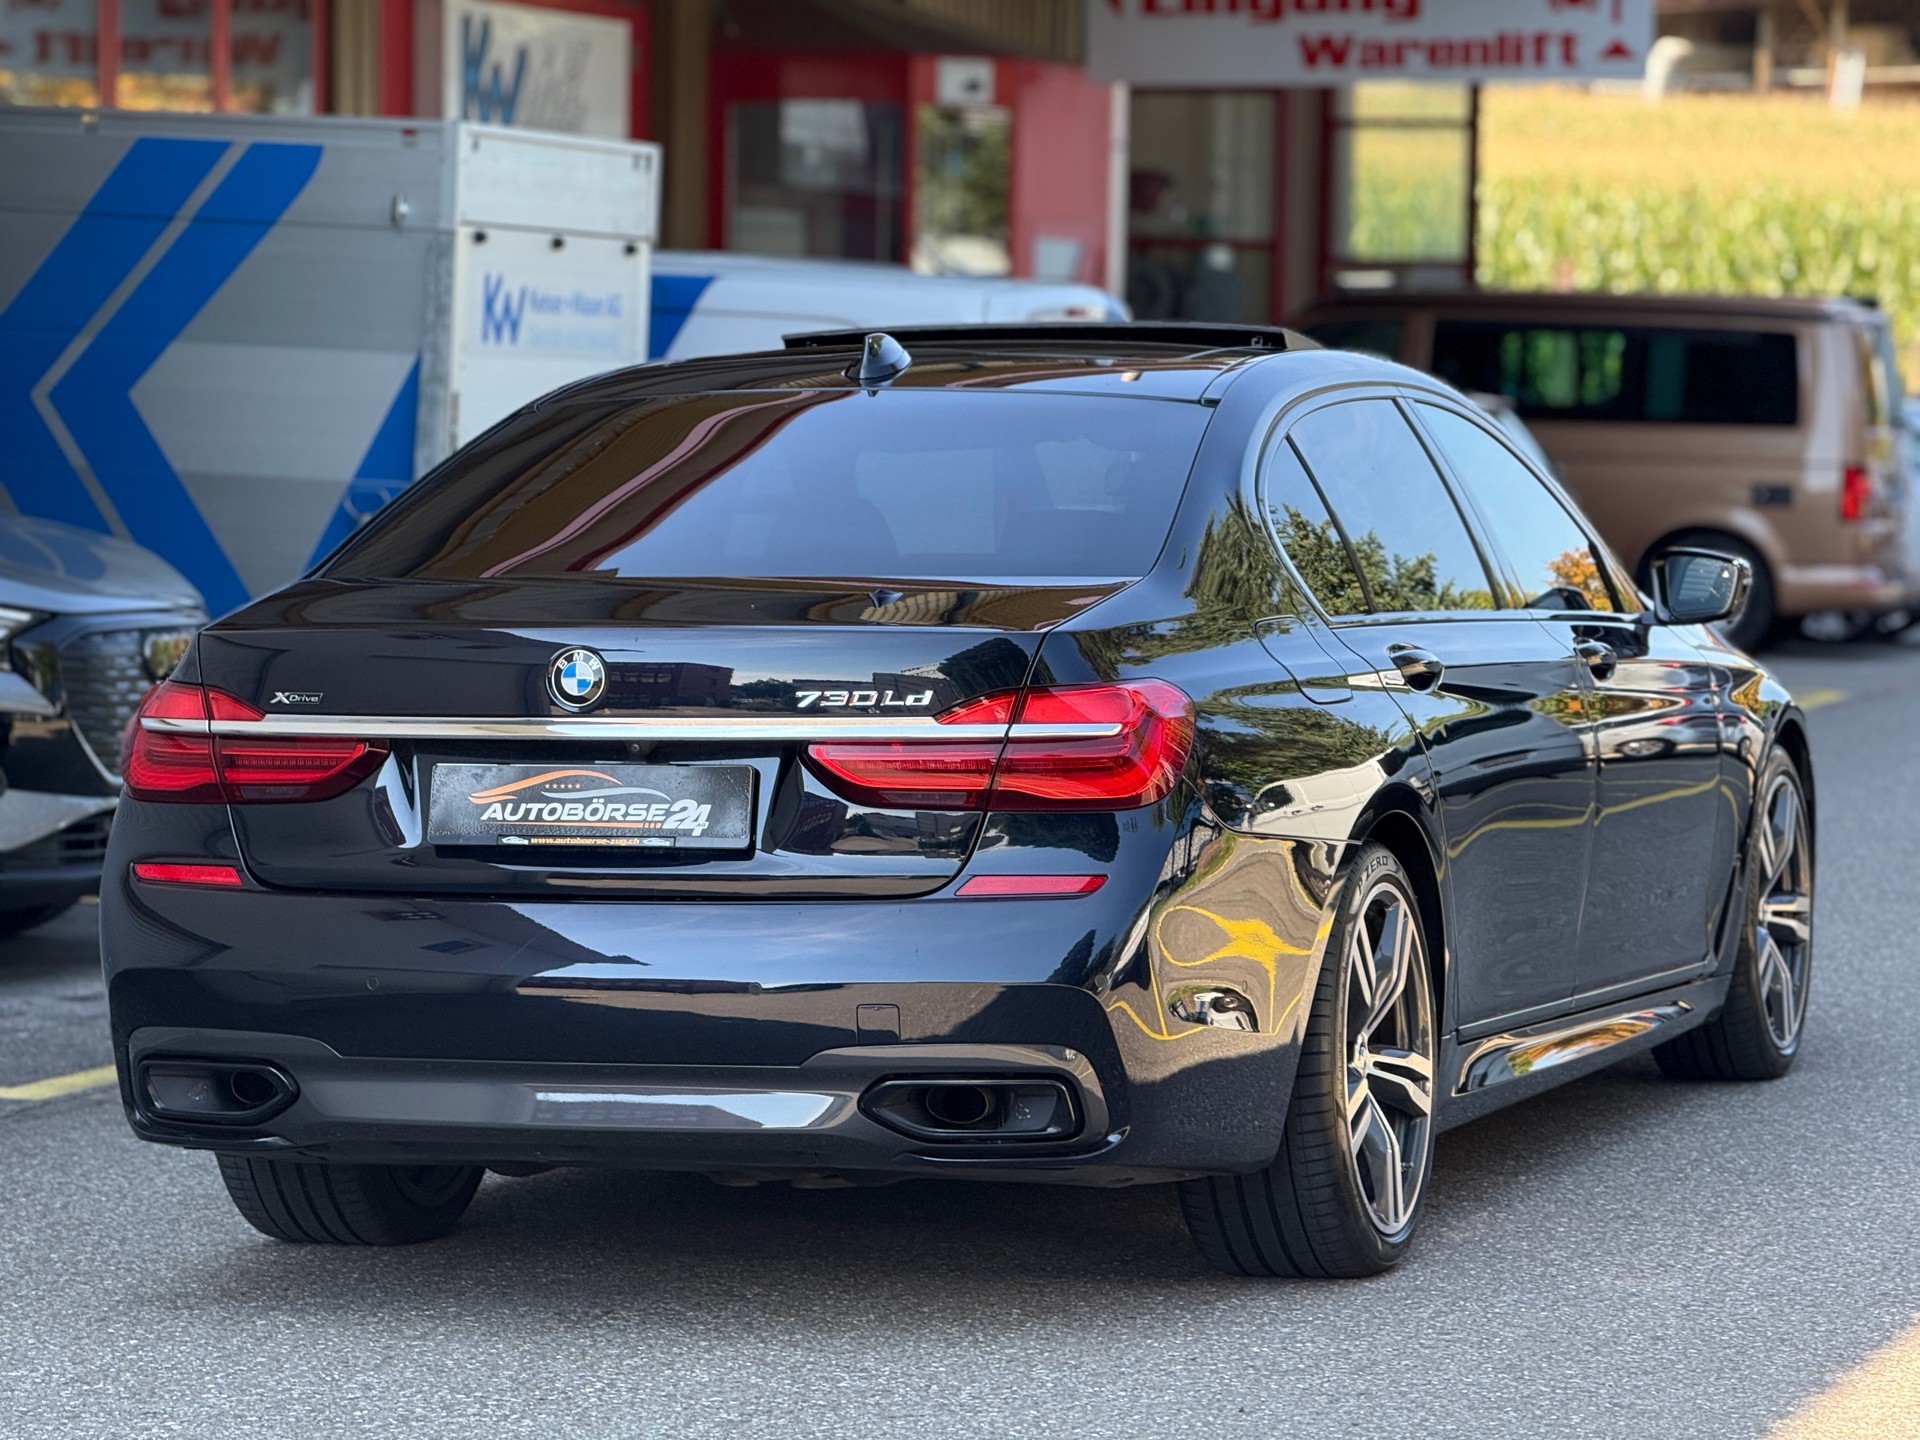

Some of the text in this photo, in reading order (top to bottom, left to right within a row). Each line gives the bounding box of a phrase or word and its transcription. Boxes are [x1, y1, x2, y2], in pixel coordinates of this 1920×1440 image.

[1296, 32, 1579, 69] Warenlift
[481, 271, 529, 345] KW
[557, 652, 601, 671] BMW
[530, 836, 640, 846] www.autoboerse-zug.ch
